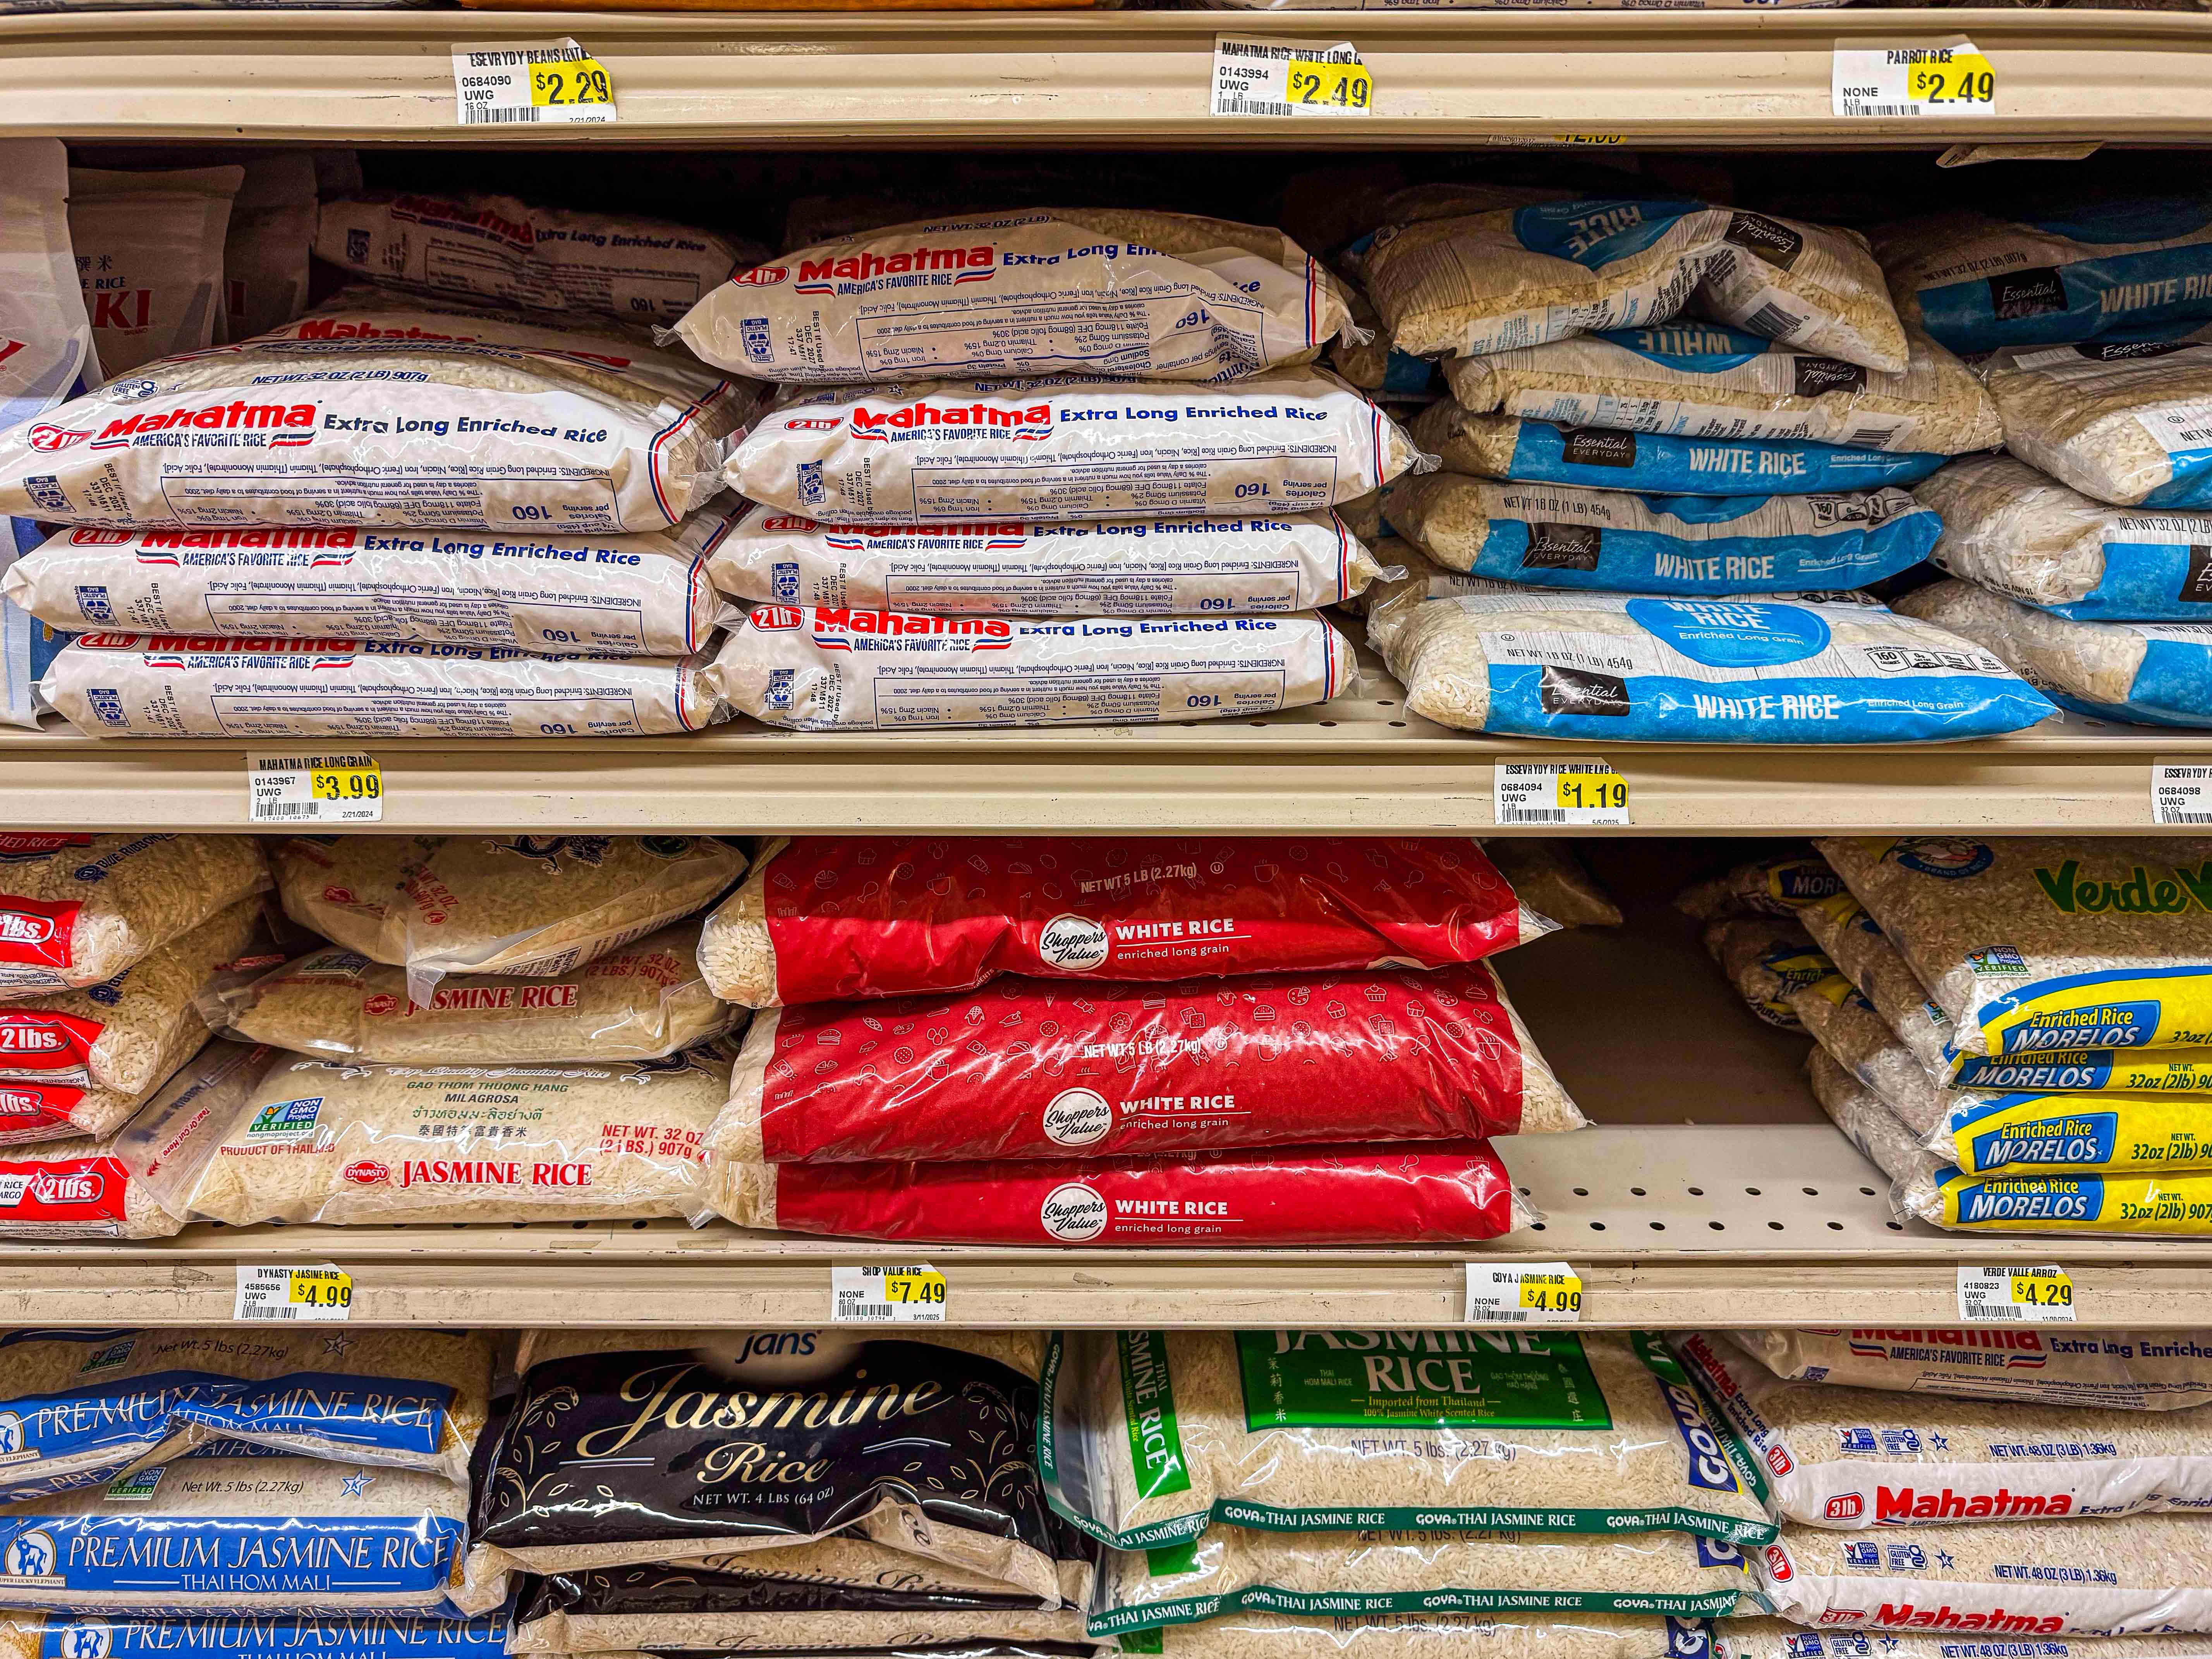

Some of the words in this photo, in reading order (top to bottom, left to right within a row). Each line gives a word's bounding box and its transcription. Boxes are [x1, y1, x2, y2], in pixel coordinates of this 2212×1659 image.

[527, 48, 560, 65] BEANS
[1222, 42, 1268, 58] MAHATMA
[1271, 46, 1292, 60] RICE
[1296, 49, 1324, 63] WHITE
[1327, 51, 1352, 65] LONG
[1887, 49, 1929, 64] PARROT
[1930, 49, 1953, 64] RICE
[1219, 66, 1269, 79] 0143994
[462, 76, 511, 87] 0684090
[536, 70, 608, 105] $2.29
[1220, 79, 1249, 91] UWG
[1293, 71, 1368, 108] $2.49
[1917, 71, 1994, 103] $2.49
[465, 91, 494, 101] UWG
[1843, 87, 1878, 96] NONE
[798, 245, 994, 282] Mahatma
[837, 279, 884, 296] AMERICA'S
[886, 275, 929, 289] FAVORITE
[931, 273, 952, 286] RICE
[98, 400, 317, 440] Mahatma
[1060, 409, 1118, 422] Extra
[1126, 407, 1179, 421] Long
[1186, 405, 1279, 421] Enriched
[1284, 407, 1328, 421] Rice
[1288, 445, 1337, 453] INGREDIENTS:
[1573, 434, 1627, 450] Essential
[1573, 449, 1626, 459] EVERYDAY
[1689, 448, 1752, 472] WHITE
[1758, 452, 1807, 475] RICE
[1235, 482, 1271, 499] 160
[1535, 498, 1547, 510] 16
[1548, 498, 1560, 511] OZ
[1561, 500, 1570, 514] (1
[1572, 501, 1588, 517] LB)
[1590, 503, 1611, 521] 454g
[1783, 694, 1839, 720] RICE
[1911, 700, 1934, 710] Long
[1937, 701, 1964, 709] Grain
[259, 758, 302, 770] MAHATMA
[325, 756, 345, 768] LONG
[347, 756, 372, 767] GRAIN
[1506, 764, 1547, 775] ESSEVRYDY
[1550, 764, 1567, 774] RICE
[1568, 764, 1594, 774] WHITE
[1595, 765, 1609, 774] LNG
[255, 776, 295, 786] 0143967
[2164, 768, 2207, 778] ESSEVRYDY
[317, 774, 379, 800] $3.99
[1563, 782, 1626, 808] $1.19
[1502, 794, 1527, 802] UWG
[1081, 880, 1102, 893] NET
[1104, 876, 1122, 890] WT
[1124, 873, 1131, 886] 5
[1133, 870, 1149, 884] LB
[1151, 862, 1197, 881] (2.27kg)
[2033, 859, 2191, 914] Verde
[1115, 922, 1183, 940] WHITE
[1189, 918, 1235, 934] RICE
[1041, 931, 1106, 950] Shoppers
[1053, 948, 1101, 962] Value
[1118, 948, 1169, 960] enriched
[1172, 945, 1197, 957] long
[1200, 943, 1230, 957] grain
[1977, 964, 2025, 972] VERIFIED
[292, 1099, 319, 1107] NON
[445, 1094, 519, 1103] MILAGROSA
[287, 1113, 314, 1121] Project
[290, 1106, 317, 1115] GMO
[252, 1121, 313, 1131] VERIFIED
[602, 1124, 630, 1137] NET
[634, 1126, 659, 1139] WT.
[664, 1128, 682, 1140] 32
[2001, 1120, 2063, 1139] Enriched
[2065, 1120, 2092, 1136] Rice
[220, 1146, 267, 1156] PRODUCT
[271, 1146, 284, 1154] OF
[658, 1142, 692, 1159] 907g
[1985, 1138, 2099, 1165] MORELOS
[2131, 1144, 2164, 1160] 32oz
[2166, 1142, 2198, 1161] (2lb)
[347, 1168, 386, 1177] DYNASTY
[400, 1161, 521, 1188] JASMINE
[532, 1164, 592, 1185] RICE
[258, 1269, 294, 1278] DYNASTY
[862, 1266, 881, 1276] SHOP
[884, 1266, 905, 1276] VALUE
[907, 1267, 922, 1276] RICE
[1493, 1272, 1512, 1283] GOYA
[1515, 1274, 1547, 1284] JASMINE
[1549, 1274, 1565, 1285] RICE
[1984, 1267, 2006, 1277] VERDE
[2008, 1268, 2030, 1277] VALLE
[2032, 1268, 2057, 1278] ARROZ
[298, 1283, 352, 1308] $4.99
[891, 1281, 945, 1304] $7.49
[1528, 1289, 1581, 1312] $4.99
[2017, 1282, 2072, 1306] $4.29
[735, 1332, 816, 1364] jans
[1363, 1357, 1482, 1393] RICE
[576, 1361, 954, 1458] Jasmine
[1441, 1396, 1485, 1407] Thailand
[696, 1440, 842, 1485] Rice
[181, 1481, 204, 1493] Net
[205, 1480, 223, 1493] Wt.
[224, 1481, 233, 1493] 5
[235, 1480, 253, 1493] lbs
[255, 1479, 304, 1495] (2.27kg)
[1876, 1486, 2072, 1520] Mahatma
[1265, 1511, 1297, 1526] THAI
[1300, 1512, 1354, 1525] JASMINE
[1357, 1512, 1385, 1525] RICE
[68, 1536, 221, 1569] PREMIUM
[227, 1535, 373, 1570] JASMINE
[381, 1535, 451, 1569] RICE
[1891, 1548, 1911, 1559] GLUTEN
[1892, 1558, 1906, 1566] FREE
[181, 1573, 229, 1590] THAI
[230, 1574, 280, 1591] HOM
[282, 1574, 330, 1591] MALI
[1994, 1565, 2012, 1579] NET
[2013, 1565, 2031, 1579] WT.
[2032, 1567, 2043, 1579] 48
[2044, 1567, 2058, 1581] OZ
[2087, 1568, 2117, 1585] 1.36kg
